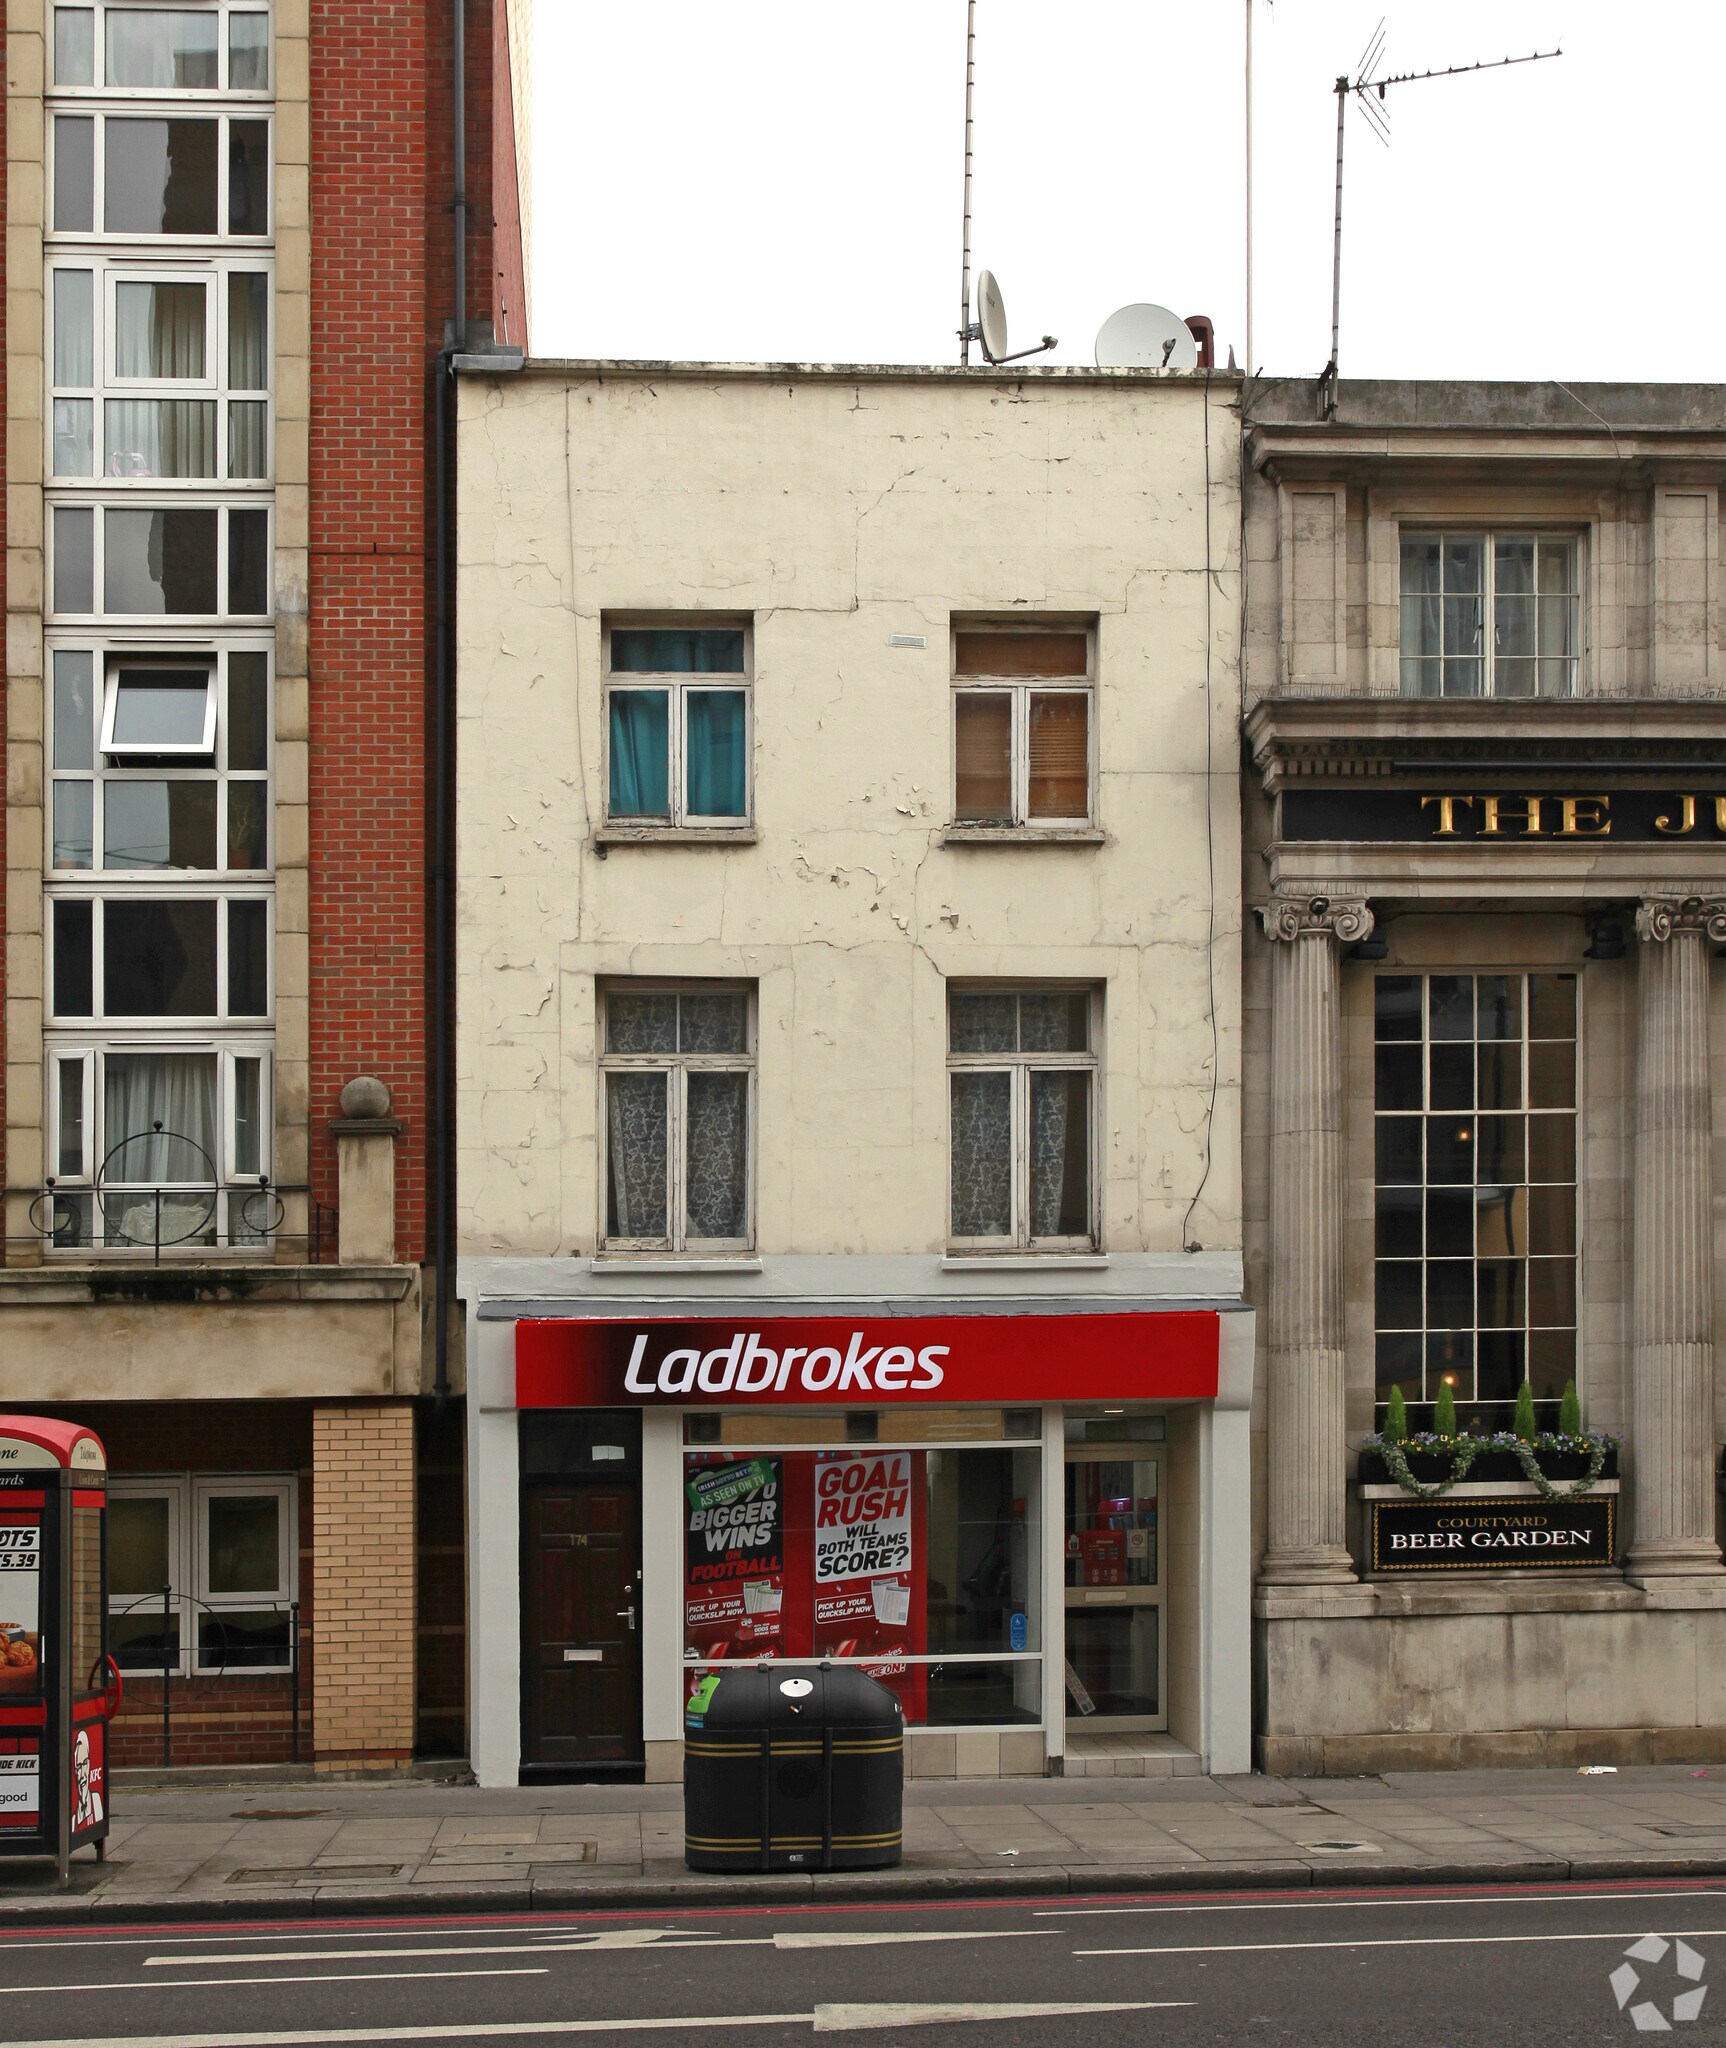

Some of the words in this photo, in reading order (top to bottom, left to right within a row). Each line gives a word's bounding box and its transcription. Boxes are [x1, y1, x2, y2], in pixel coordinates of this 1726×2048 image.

[1421, 795, 1612, 835] THE
[624, 1332, 950, 1394] Ladbrokes
[0, 1449, 19, 1459] ne
[698, 1480, 716, 1492] IRISH
[735, 1469, 747, 1479] BET
[818, 1458, 908, 1498] GOAL
[701, 1495, 713, 1507] AS
[713, 1485, 737, 1502] SEEN
[739, 1480, 752, 1492] ON
[753, 1474, 766, 1487] TV
[690, 1500, 777, 1531] BIGGER
[817, 1488, 909, 1528] RUSH
[846, 1523, 879, 1538] WILL
[1437, 1516, 1548, 1529] COURTYARD
[570, 1534, 588, 1546] 174
[817, 1540, 856, 1556] BOTH
[860, 1532, 908, 1549] TEAMS
[1390, 1531, 1466, 1549] BEER
[1471, 1529, 1592, 1547] GARDEN
[725, 1549, 741, 1560] ON
[817, 1545, 909, 1577] SCORE?
[691, 1555, 781, 1582] FOOTBALL
[689, 1604, 705, 1613] PICK
[722, 1600, 741, 1608] YOUR
[818, 1602, 834, 1610] PICK
[848, 1598, 866, 1606] YOUR
[818, 1608, 854, 1618] QUICKSLIP
[855, 1605, 872, 1613] NOW
[689, 1609, 726, 1621] QUICKSLIP
[727, 1607, 744, 1616] NOW
[16, 1759, 37, 1769] KICK
[89, 1766, 102, 1784] KFC
[0, 1792, 28, 1804] good
